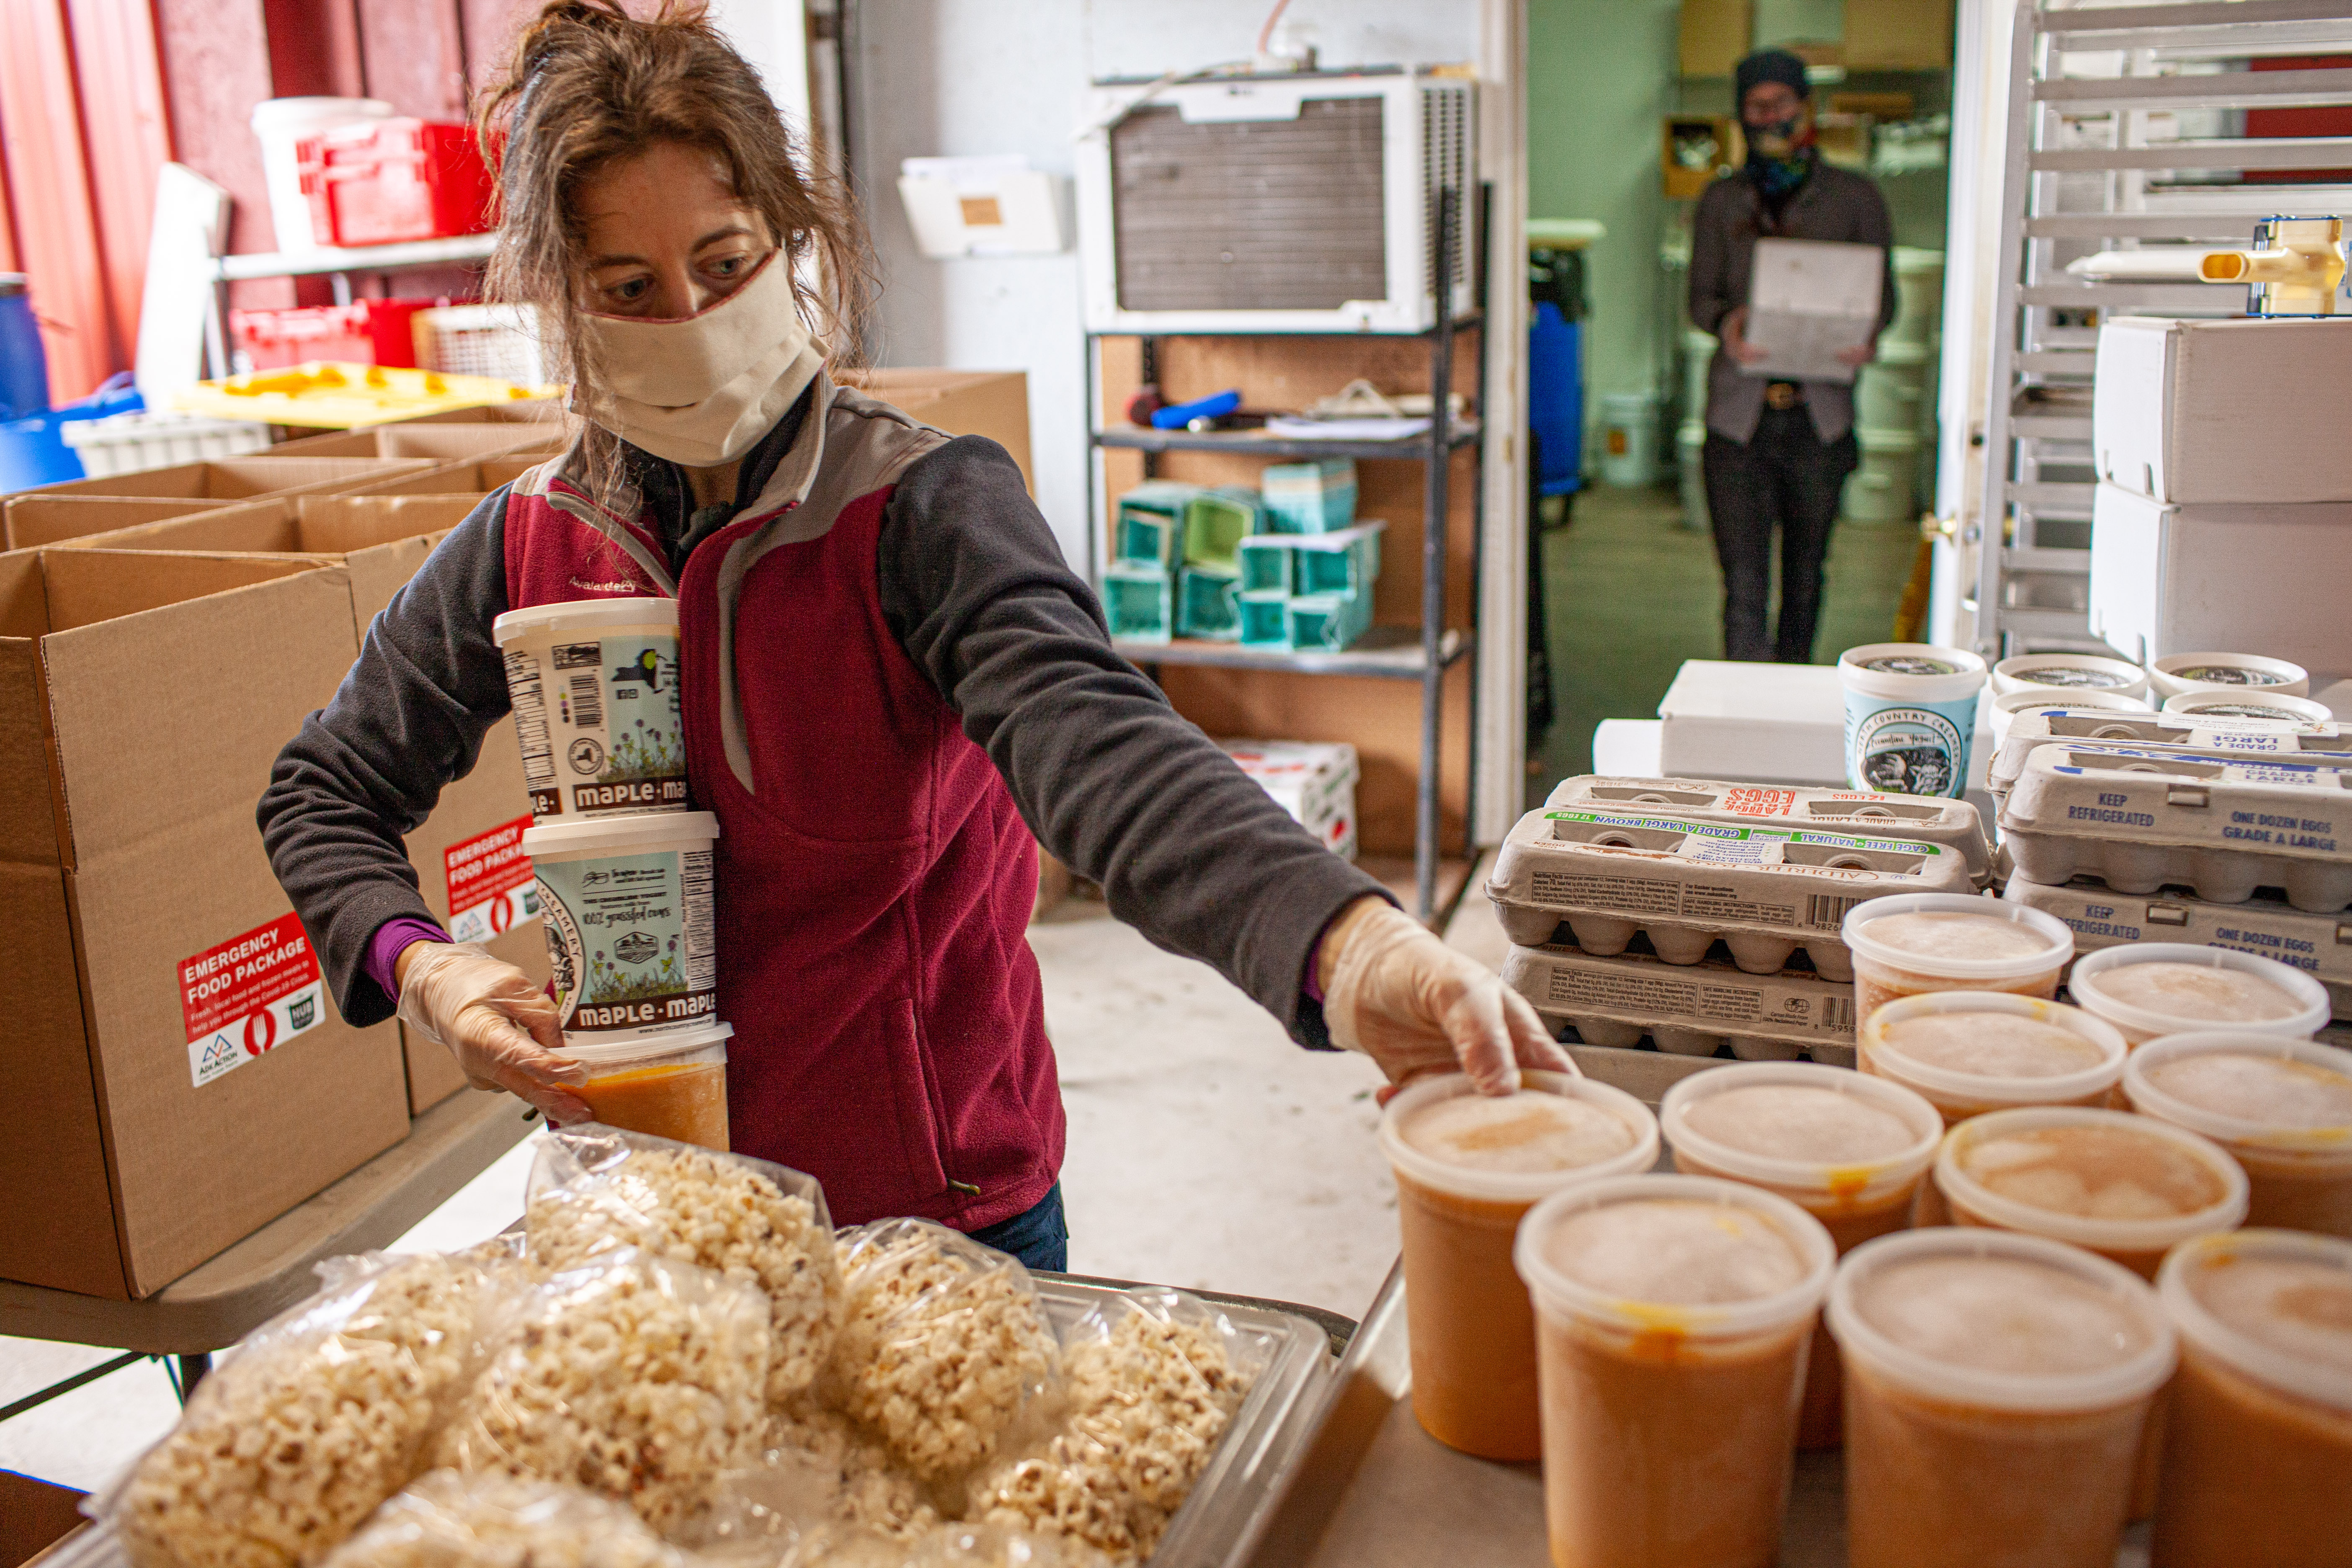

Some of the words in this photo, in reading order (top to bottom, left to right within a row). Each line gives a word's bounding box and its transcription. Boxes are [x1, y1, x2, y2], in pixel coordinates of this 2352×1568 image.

[1874, 712, 1926, 724] COUNTRY
[1932, 718, 1959, 766] CREAMERY
[1910, 733, 1935, 745] Yogurt
[2213, 735, 2279, 744] LARGE
[2245, 775, 2317, 784] LARGE
[1727, 788, 1796, 805] EGGS
[2098, 793, 2128, 807] KEEP
[1721, 805, 1791, 815] LARGE
[2068, 805, 2155, 826] REFRIGERATED
[1594, 815, 1645, 826] BROWN
[1643, 818, 1683, 831] LARGE
[2231, 811, 2255, 824] ONE
[2257, 814, 2298, 828] DOZEN
[2301, 819, 2332, 833] EGGS
[1698, 826, 1740, 838] GRADE
[1802, 833, 1856, 847] NATURAL
[2222, 826, 2271, 843] GRADE
[2275, 833, 2286, 845] A
[2289, 834, 2337, 851] LARGE
[448, 825, 519, 869] EMERGENCY
[1866, 841, 1893, 850] FREE
[1896, 843, 1929, 853] CAGE
[449, 859, 483, 887] FOOD
[484, 841, 524, 872] PACKA
[606, 906, 647, 928] grassfed
[648, 907, 672, 918] cows
[2086, 904, 2115, 919] KEEP
[2216, 927, 2240, 941] ONE
[2243, 931, 2282, 948] DOZEN
[2285, 937, 2315, 954] EGGS
[185, 927, 279, 984] EMERGENCY
[188, 972, 232, 1004] FOOD
[235, 936, 307, 983] PACKAGE
[214, 996, 232, 1010] local
[232, 988, 248, 1002] food
[248, 982, 261, 995] and
[261, 973, 282, 988] frozen
[282, 963, 302, 977] meals
[302, 959, 310, 969] to
[192, 1022, 209, 1035] help
[209, 1015, 223, 1027] you
[222, 1002, 249, 1020] through
[249, 995, 261, 1007] the
[292, 1001, 313, 1018] HUB
[1831, 1024, 1855, 1033] 5959
